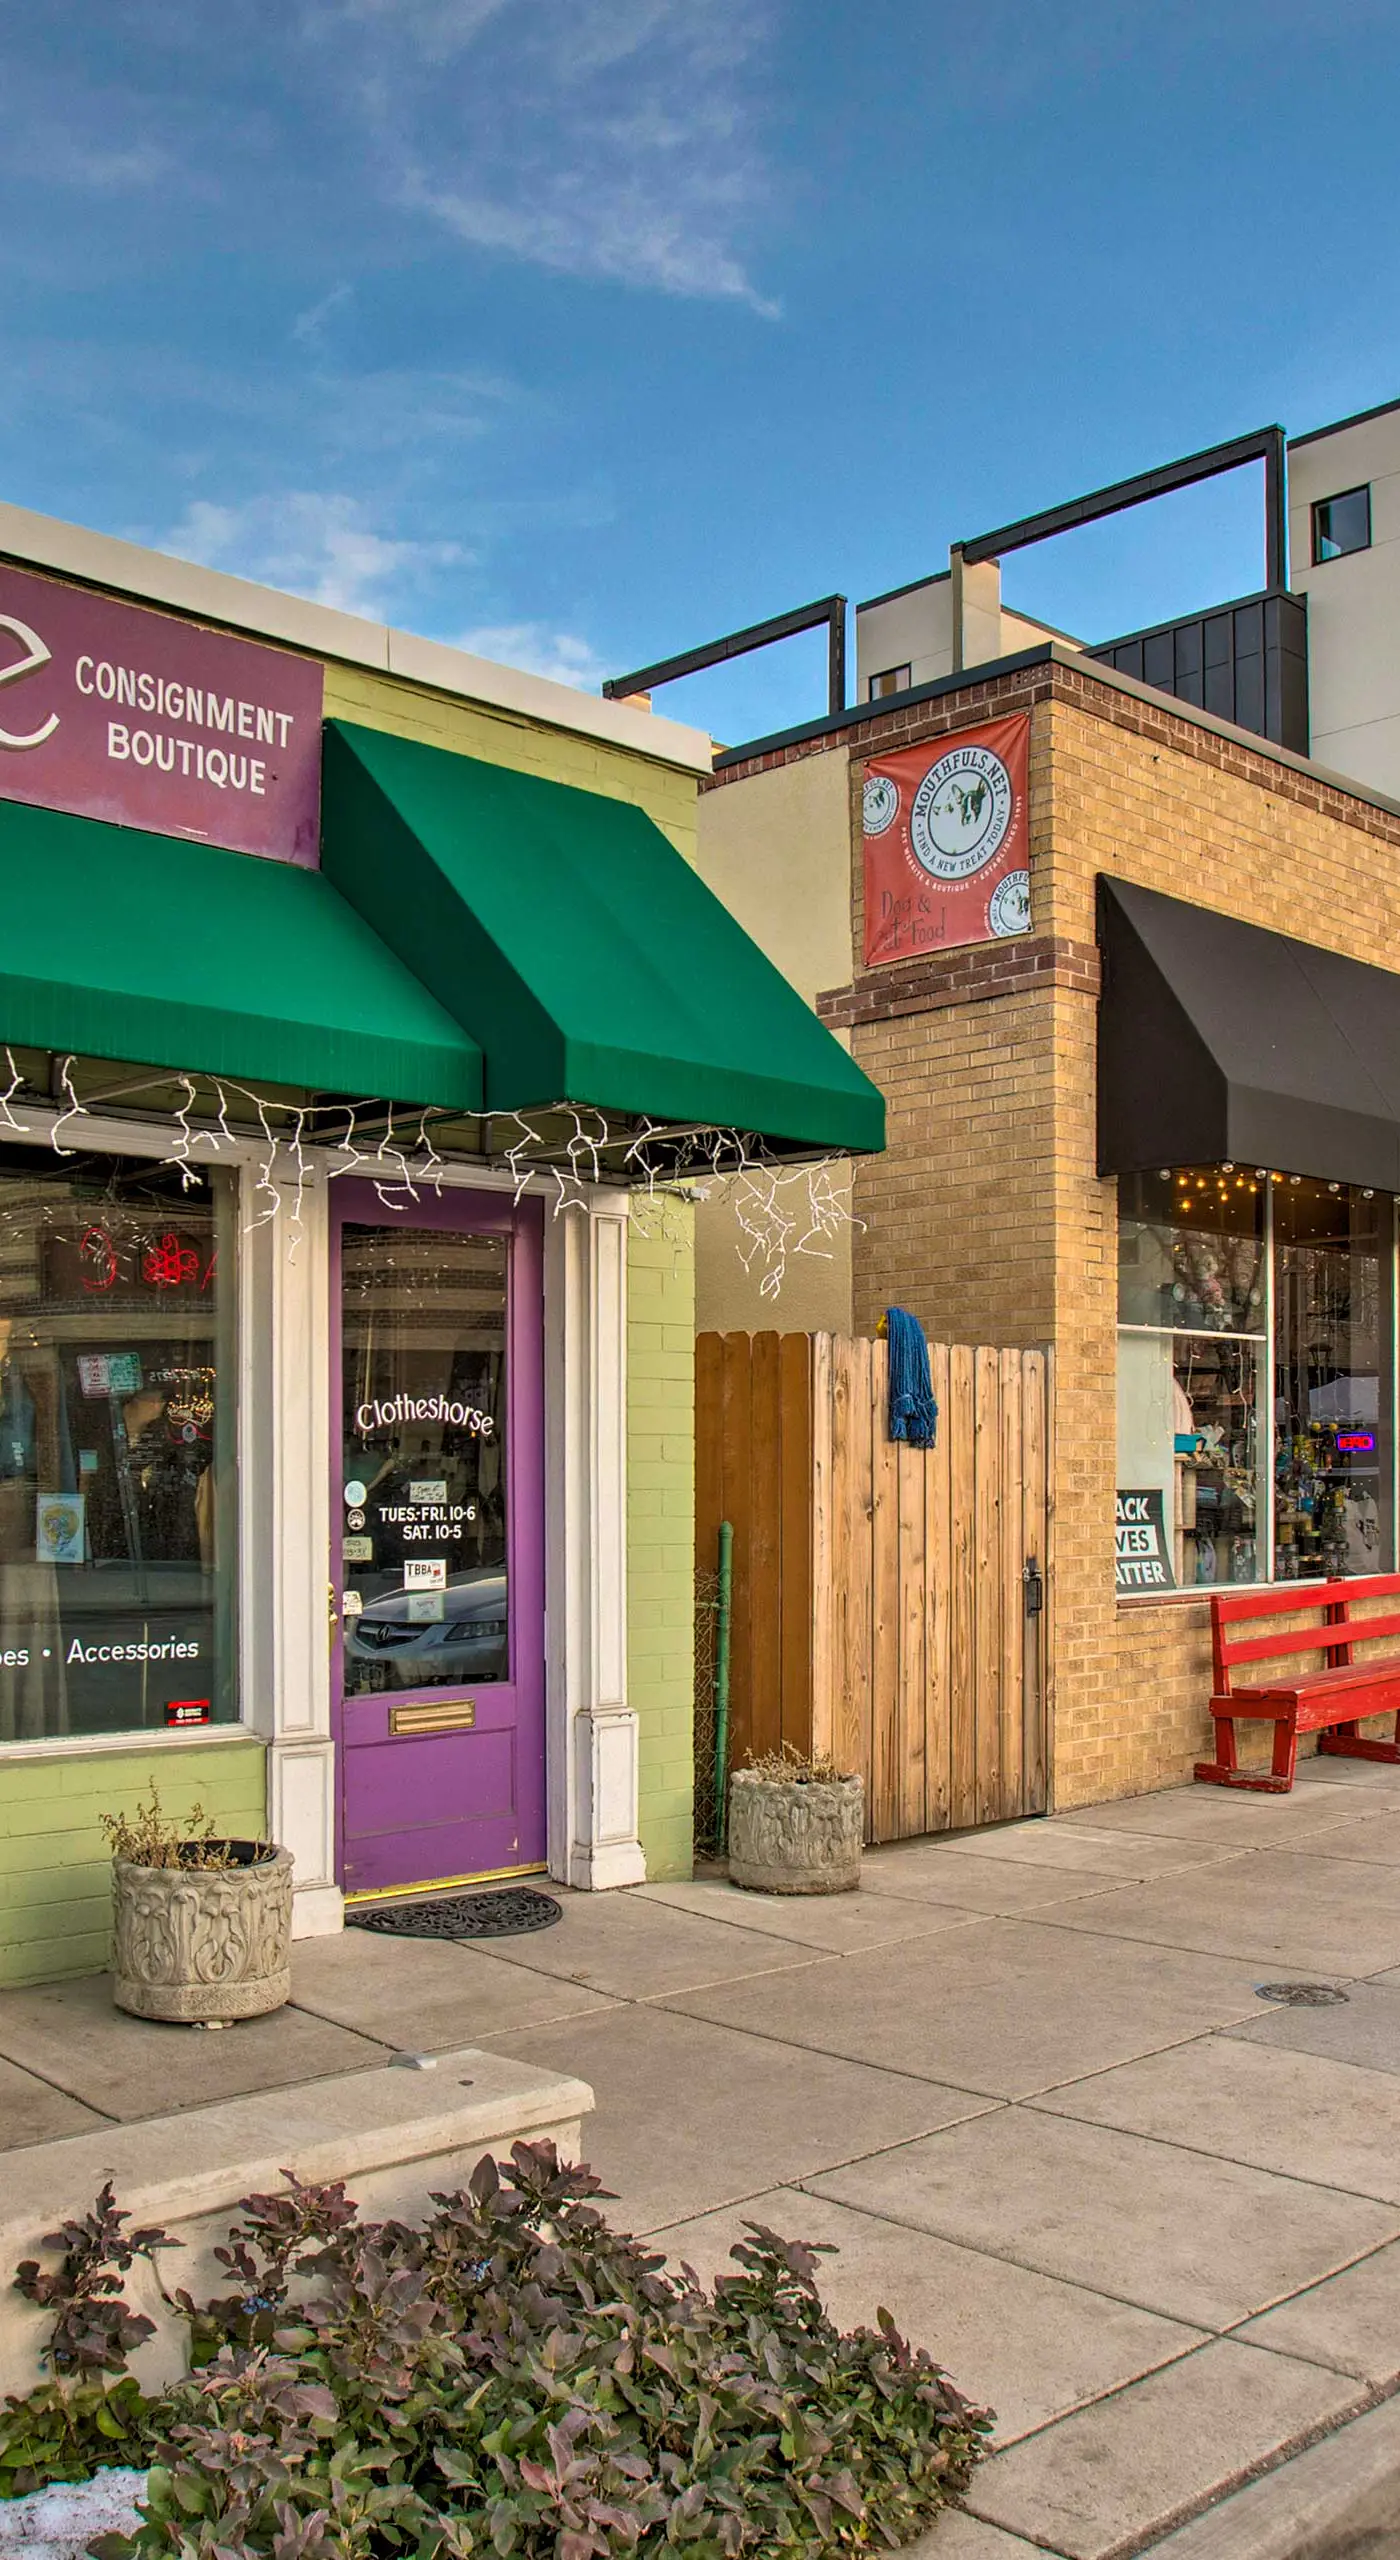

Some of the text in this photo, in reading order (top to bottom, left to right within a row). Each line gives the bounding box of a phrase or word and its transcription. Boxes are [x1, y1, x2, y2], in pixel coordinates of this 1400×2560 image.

[75, 656, 294, 748] CONSIGNMENT
[107, 721, 266, 795] BOUTIQUE
[914, 751, 1008, 818] MOUTHFULS.NET
[916, 808, 1006, 872] FIND A NEW TREAT TODAY
[932, 882, 970, 893] BOUTIQUE
[882, 890, 912, 933] Dog
[912, 906, 946, 946] Food
[357, 1393, 494, 1435] Clotheshorse
[449, 1506, 476, 1521] 10-6
[1115, 1497, 1150, 1520] ACK
[402, 1524, 462, 1540] SAT. 10-5
[406, 1563, 432, 1577] TBBA
[67, 1635, 199, 1664] Accessories
